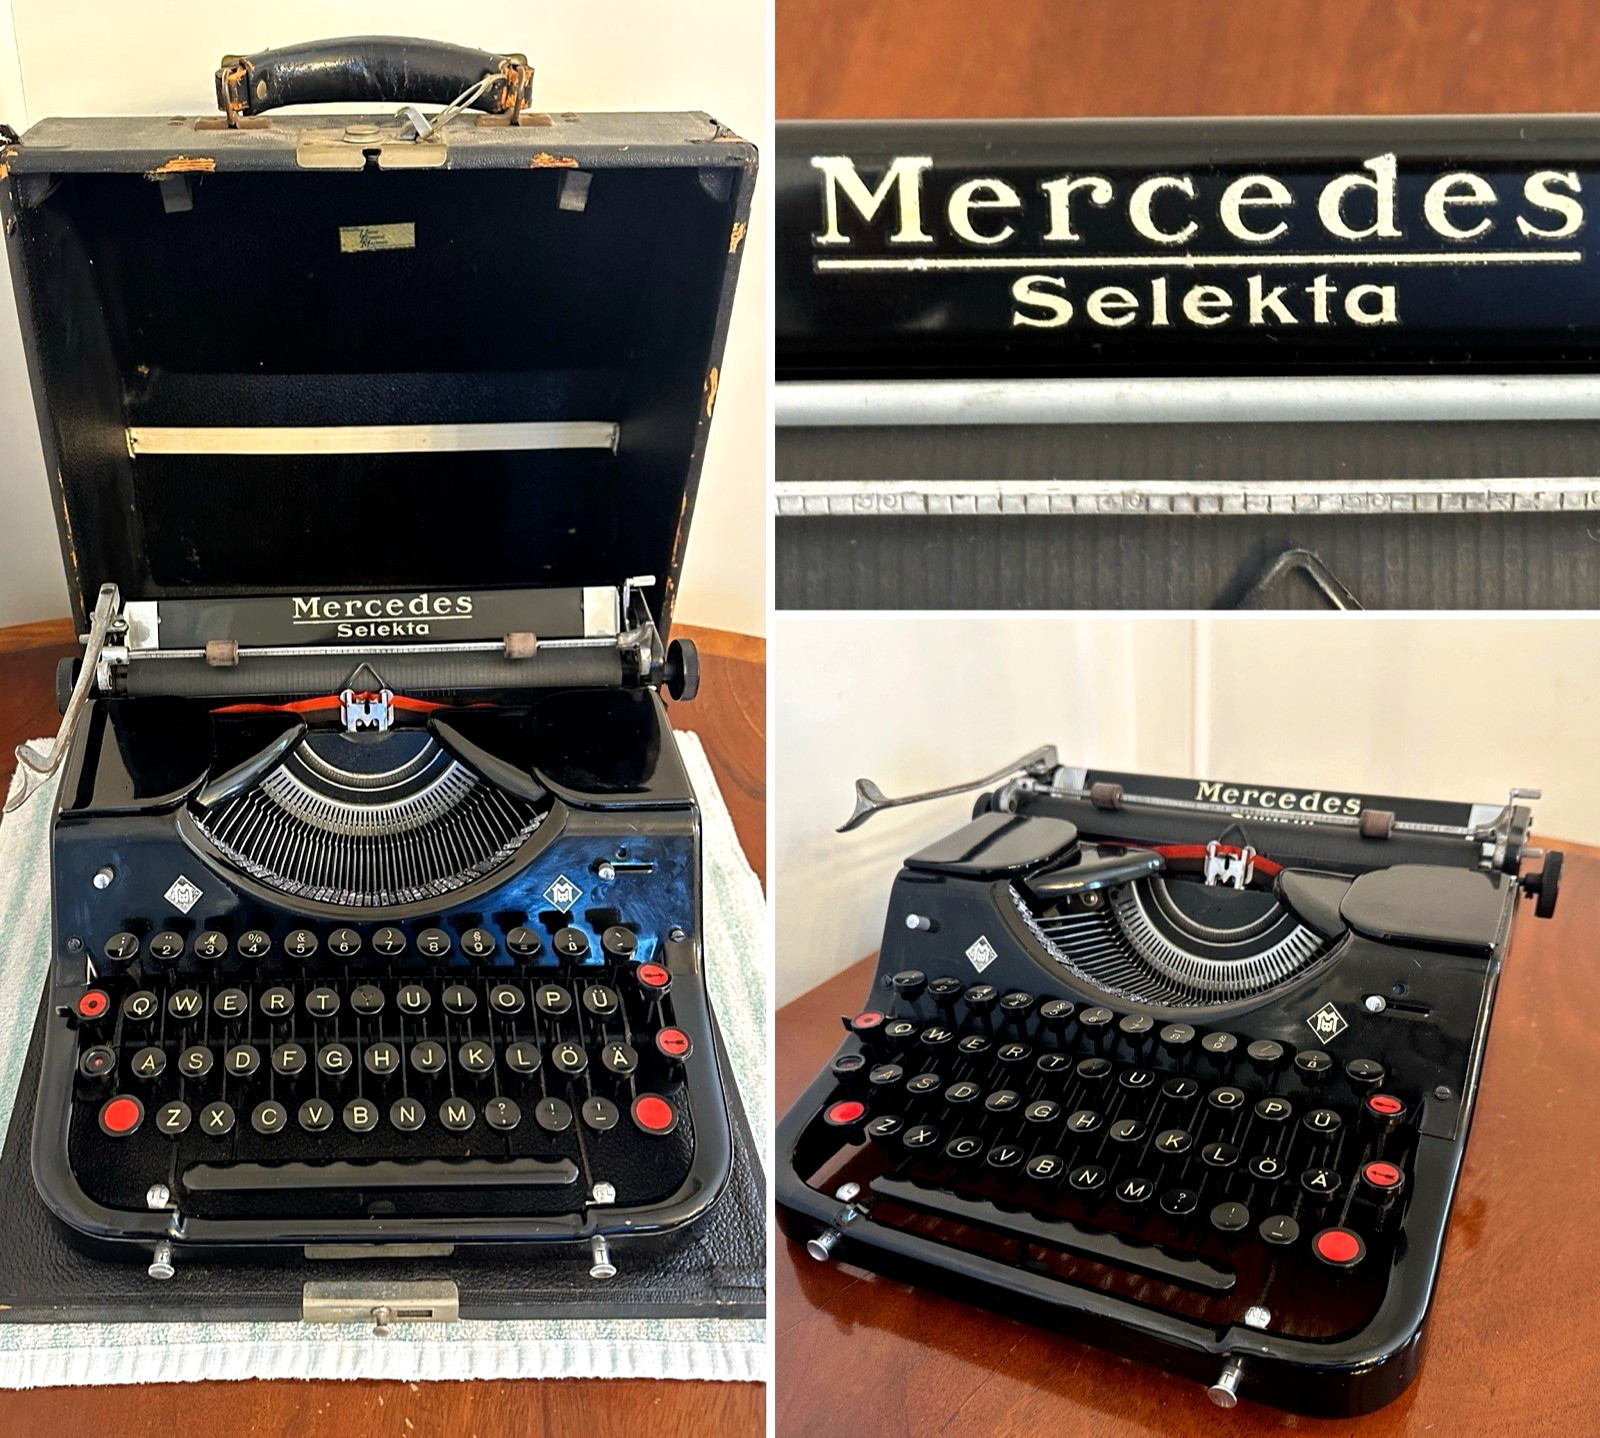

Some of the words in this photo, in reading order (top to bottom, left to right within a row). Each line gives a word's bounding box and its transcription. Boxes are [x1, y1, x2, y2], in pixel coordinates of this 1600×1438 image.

[811, 152, 1586, 246] Mercedes
[1011, 274, 1401, 328] Selekta
[292, 593, 473, 618] Mercedes
[337, 622, 430, 638] Selekta
[1195, 781, 1362, 816] Mercedes
[162, 944, 171, 955] 2
[205, 945, 215, 955] 3
[248, 944, 258, 953] 4
[296, 943, 305, 954] 5
[340, 942, 349, 952] 6
[385, 941, 394, 951] 7
[429, 941, 439, 952] 8
[473, 942, 483, 952] 9
[248, 933, 262, 944] %
[132, 997, 150, 1016] Q
[175, 995, 198, 1012] W
[223, 995, 238, 1011] E
[270, 994, 285, 1010] R
[316, 995, 330, 1010] T
[406, 992, 421, 1008] U
[457, 992, 463, 1007] I
[498, 991, 516, 1007] O
[545, 991, 561, 1007] P
[592, 989, 608, 1008] Ü
[140, 1054, 156, 1070] A
[188, 1053, 204, 1070] S
[235, 1051, 251, 1069] D
[283, 1050, 297, 1067] F
[326, 1050, 343, 1068] G
[374, 1050, 390, 1067] H
[421, 1048, 433, 1066] J
[468, 1048, 485, 1065] K
[517, 1049, 531, 1066] L
[561, 1046, 579, 1066] Ö
[612, 1046, 629, 1066] Ä
[893, 1022, 913, 1036] Q
[928, 1028, 952, 1041] W
[966, 1038, 985, 1050] E
[1005, 1046, 1024, 1058] R
[1049, 1055, 1065, 1068] T
[1129, 1071, 1147, 1084] U
[1175, 1082, 1185, 1094] I
[1217, 1092, 1236, 1104] O
[1265, 1102, 1283, 1114] P
[1314, 1112, 1331, 1127] Ü
[166, 1108, 181, 1127] Z
[209, 1110, 225, 1127] X
[261, 1108, 277, 1125] C
[308, 1106, 323, 1124] V
[353, 1106, 369, 1124] B
[400, 1106, 415, 1123] N
[447, 1105, 466, 1123] M
[877, 1069, 894, 1080] A
[916, 1078, 934, 1089] S
[954, 1085, 972, 1098] D
[994, 1094, 1014, 1106] F
[1033, 1105, 1053, 1118] G
[1076, 1114, 1096, 1128] H
[1120, 1125, 1136, 1136] J
[1165, 1134, 1184, 1148] K
[1213, 1147, 1225, 1161] L
[1258, 1156, 1277, 1173] Ö
[1310, 1170, 1329, 1188] Ä
[876, 1118, 897, 1132] Z
[911, 1129, 932, 1143] X
[956, 1140, 975, 1153] C
[999, 1148, 1016, 1161] V
[1035, 1159, 1055, 1174] B
[1078, 1170, 1098, 1185] N
[1123, 1181, 1146, 1197] M
